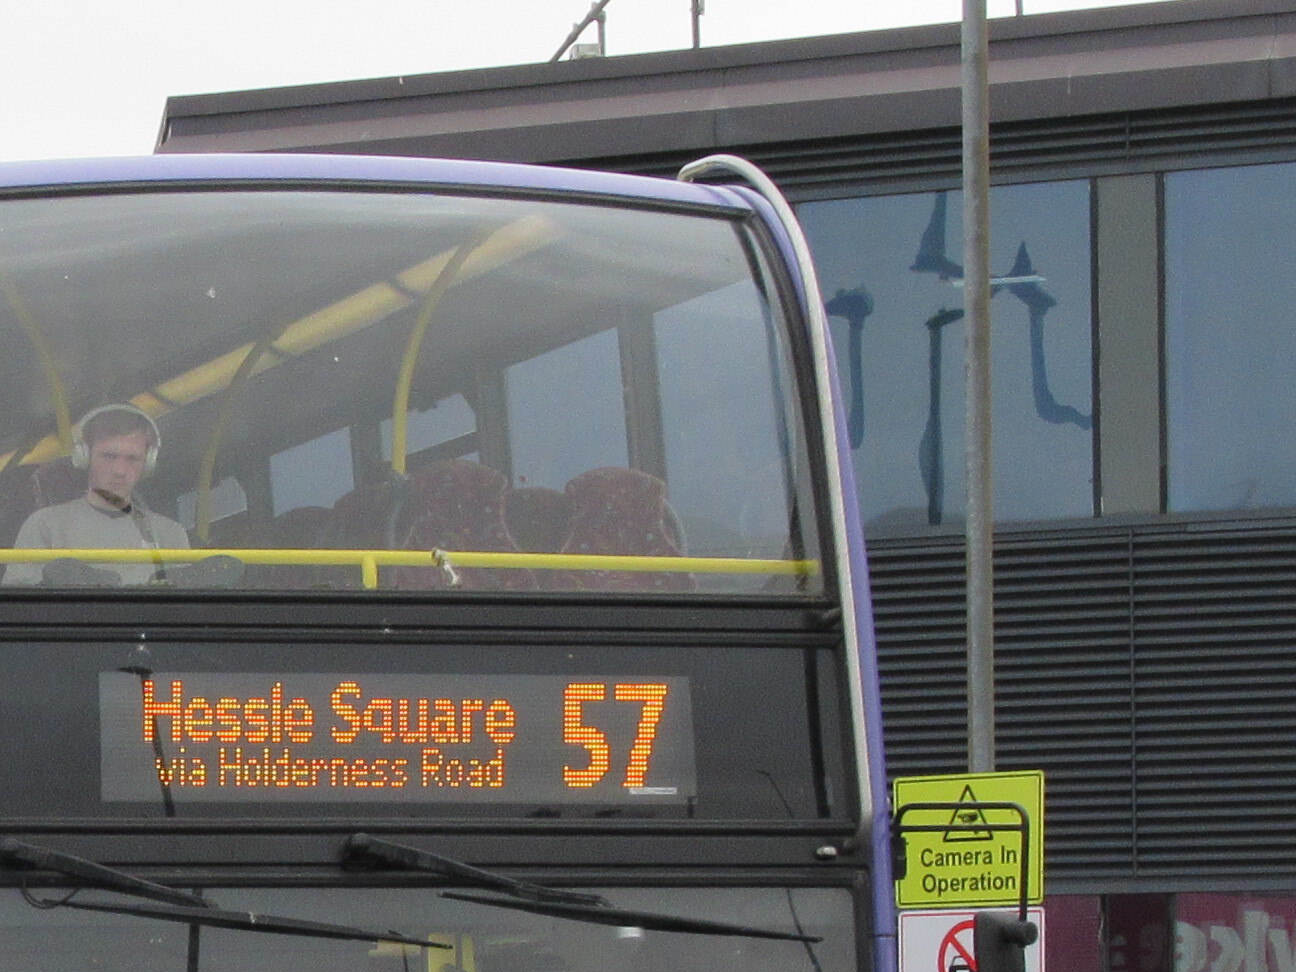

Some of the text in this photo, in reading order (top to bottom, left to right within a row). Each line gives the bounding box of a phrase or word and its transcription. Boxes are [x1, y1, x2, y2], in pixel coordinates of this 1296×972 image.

[142, 679, 517, 743] Hessle Square
[562, 682, 669, 788] 57
[156, 747, 505, 788] via Holderness Road
[920, 846, 1018, 868] Camera In
[922, 872, 1017, 897] Operation
